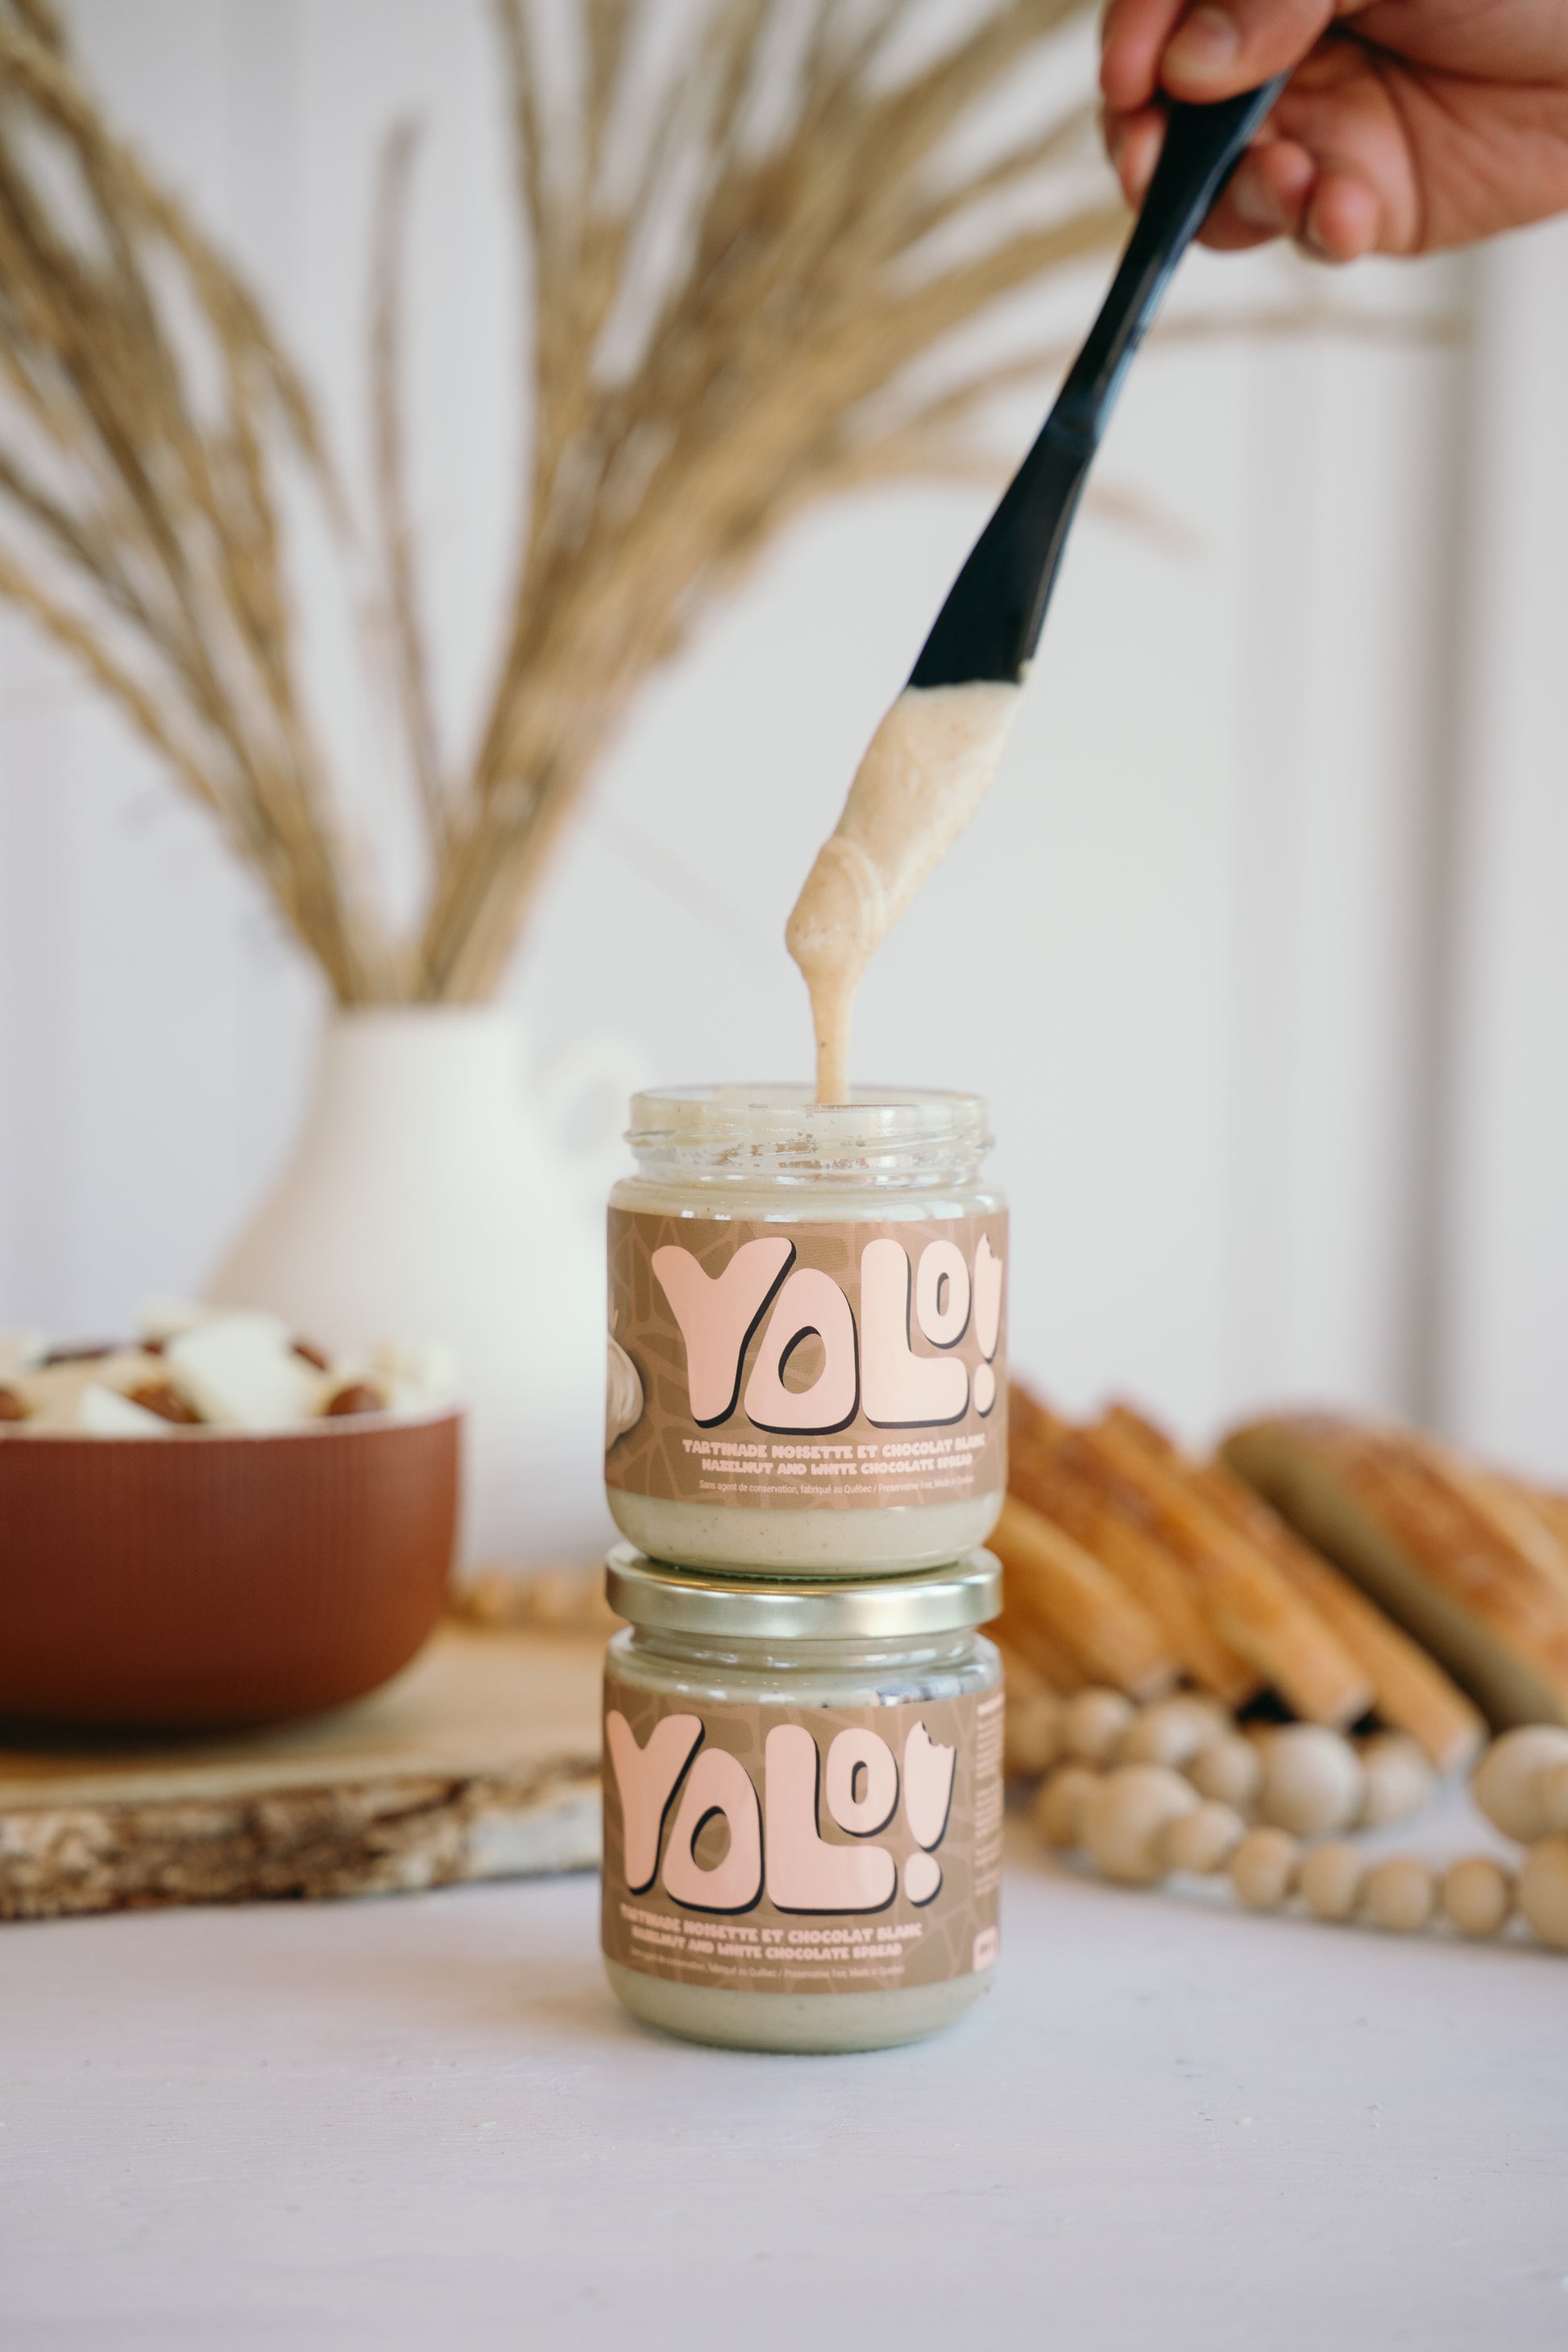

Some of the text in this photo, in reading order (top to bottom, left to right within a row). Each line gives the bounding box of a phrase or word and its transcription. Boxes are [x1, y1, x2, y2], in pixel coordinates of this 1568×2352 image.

[651, 1232, 1002, 1435] YOLO!
[682, 1439, 767, 1458] TARTINADE
[771, 1445, 852, 1459] NOISETTE
[857, 1445, 877, 1458] ET
[882, 1438, 952, 1458] CHOCOLAT
[702, 1458, 774, 1475] HAZELNUT
[777, 1463, 807, 1475] AND
[811, 1462, 857, 1475] WHITE
[861, 1458, 934, 1475] CHOCOLATE
[699, 1479, 716, 1490] Sans
[717, 1483, 737, 1494] agent
[739, 1483, 748, 1491] de
[749, 1484, 799, 1495] conservation,
[800, 1485, 832, 1495] fabriqué
[833, 1486, 842, 1494] au
[844, 1484, 872, 1495] Québec
[606, 1709, 956, 1916] YOLO!
[761, 1928, 784, 1943] ET
[788, 1927, 873, 1944] CHOCOLAT
[717, 1943, 762, 1959] WHITE
[765, 1946, 850, 1960] CHOCOLATE
